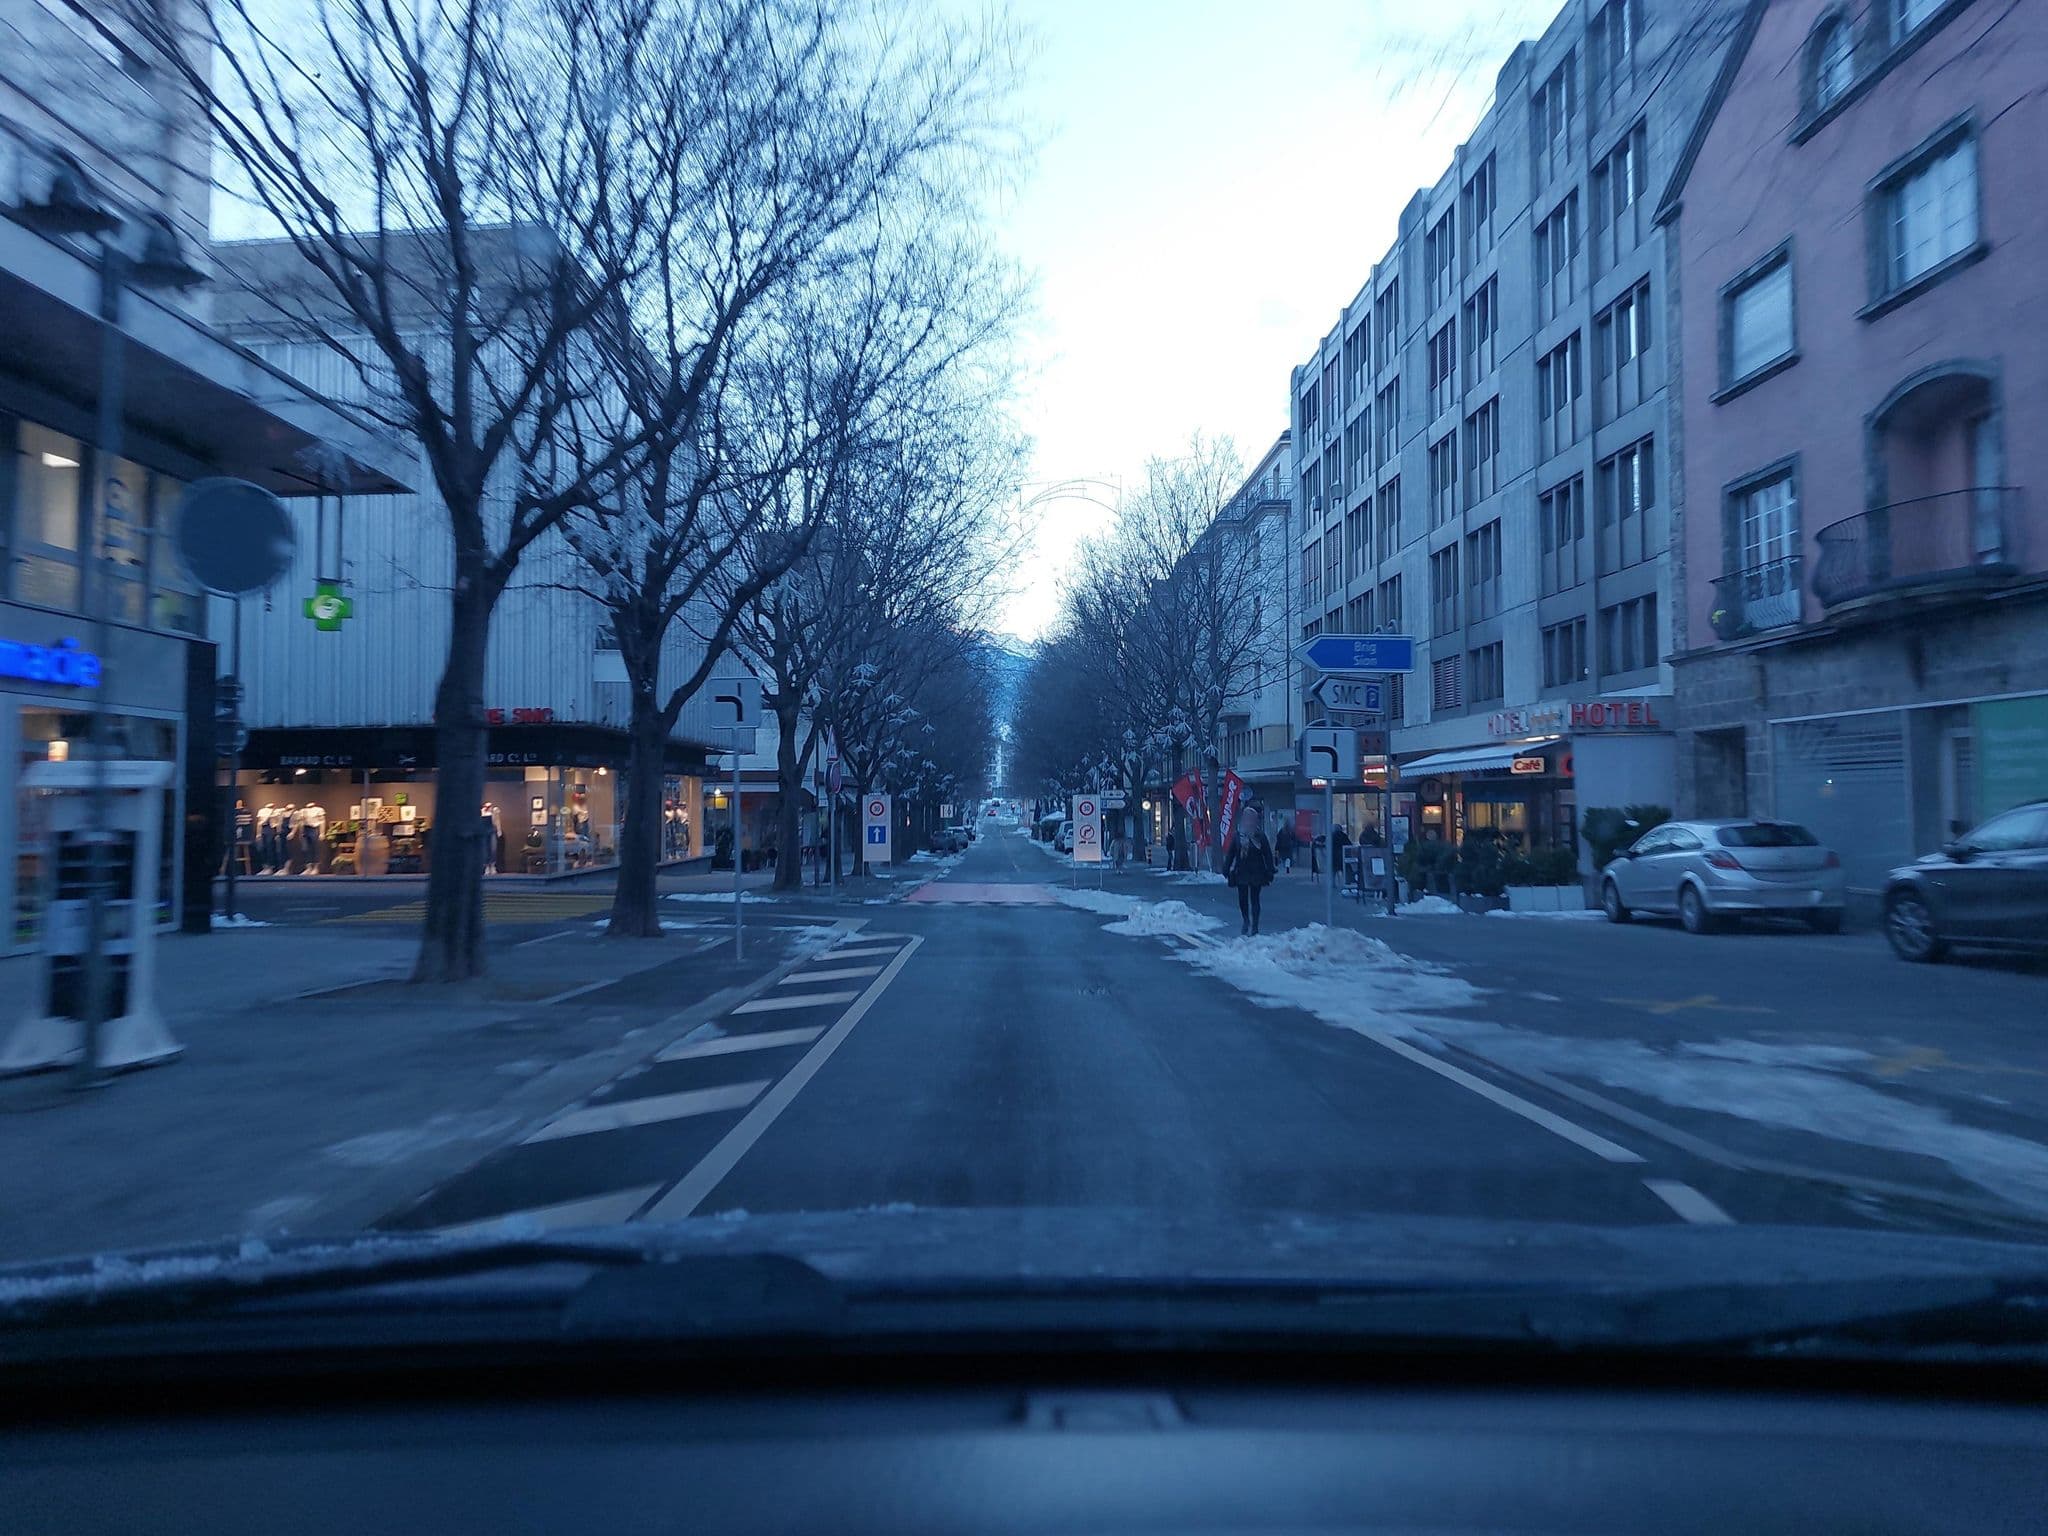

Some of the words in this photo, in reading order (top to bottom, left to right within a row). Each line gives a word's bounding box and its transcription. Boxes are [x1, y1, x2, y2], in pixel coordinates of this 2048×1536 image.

[1354, 641, 1377, 655] Brig
[1354, 655, 1377, 666] Sion
[1332, 684, 1361, 705] SMC
[1569, 702, 1660, 728] HOTEL
[1513, 759, 1541, 772] Café
[1083, 804, 1091, 812] 30
